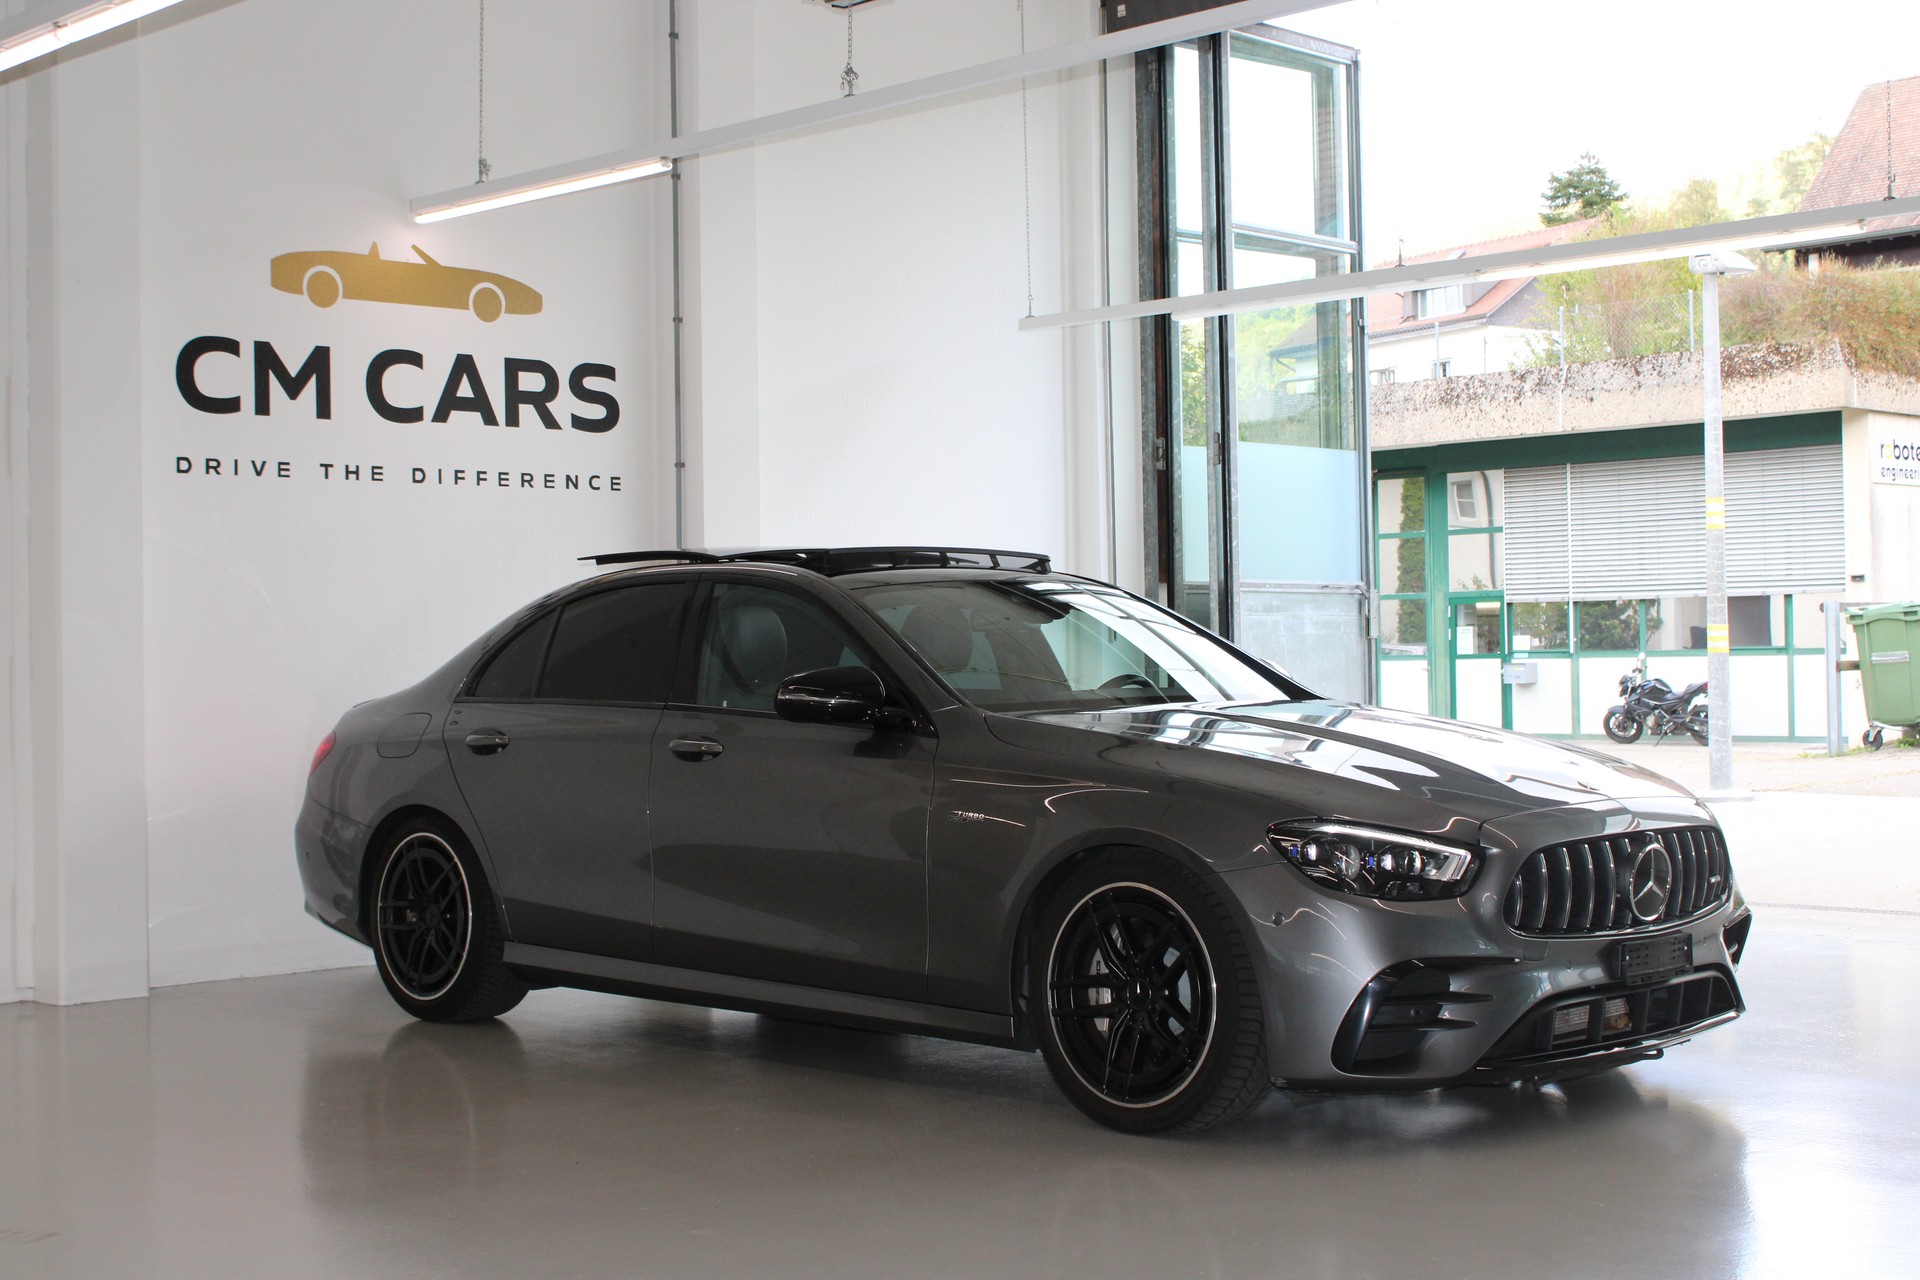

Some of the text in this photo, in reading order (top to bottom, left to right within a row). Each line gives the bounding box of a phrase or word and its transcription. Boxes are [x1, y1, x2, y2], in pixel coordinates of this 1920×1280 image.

[176, 336, 621, 433] CM CARS
[176, 456, 622, 491] DRIVE THE DIFFERENCE
[957, 811, 985, 819] TURBO
